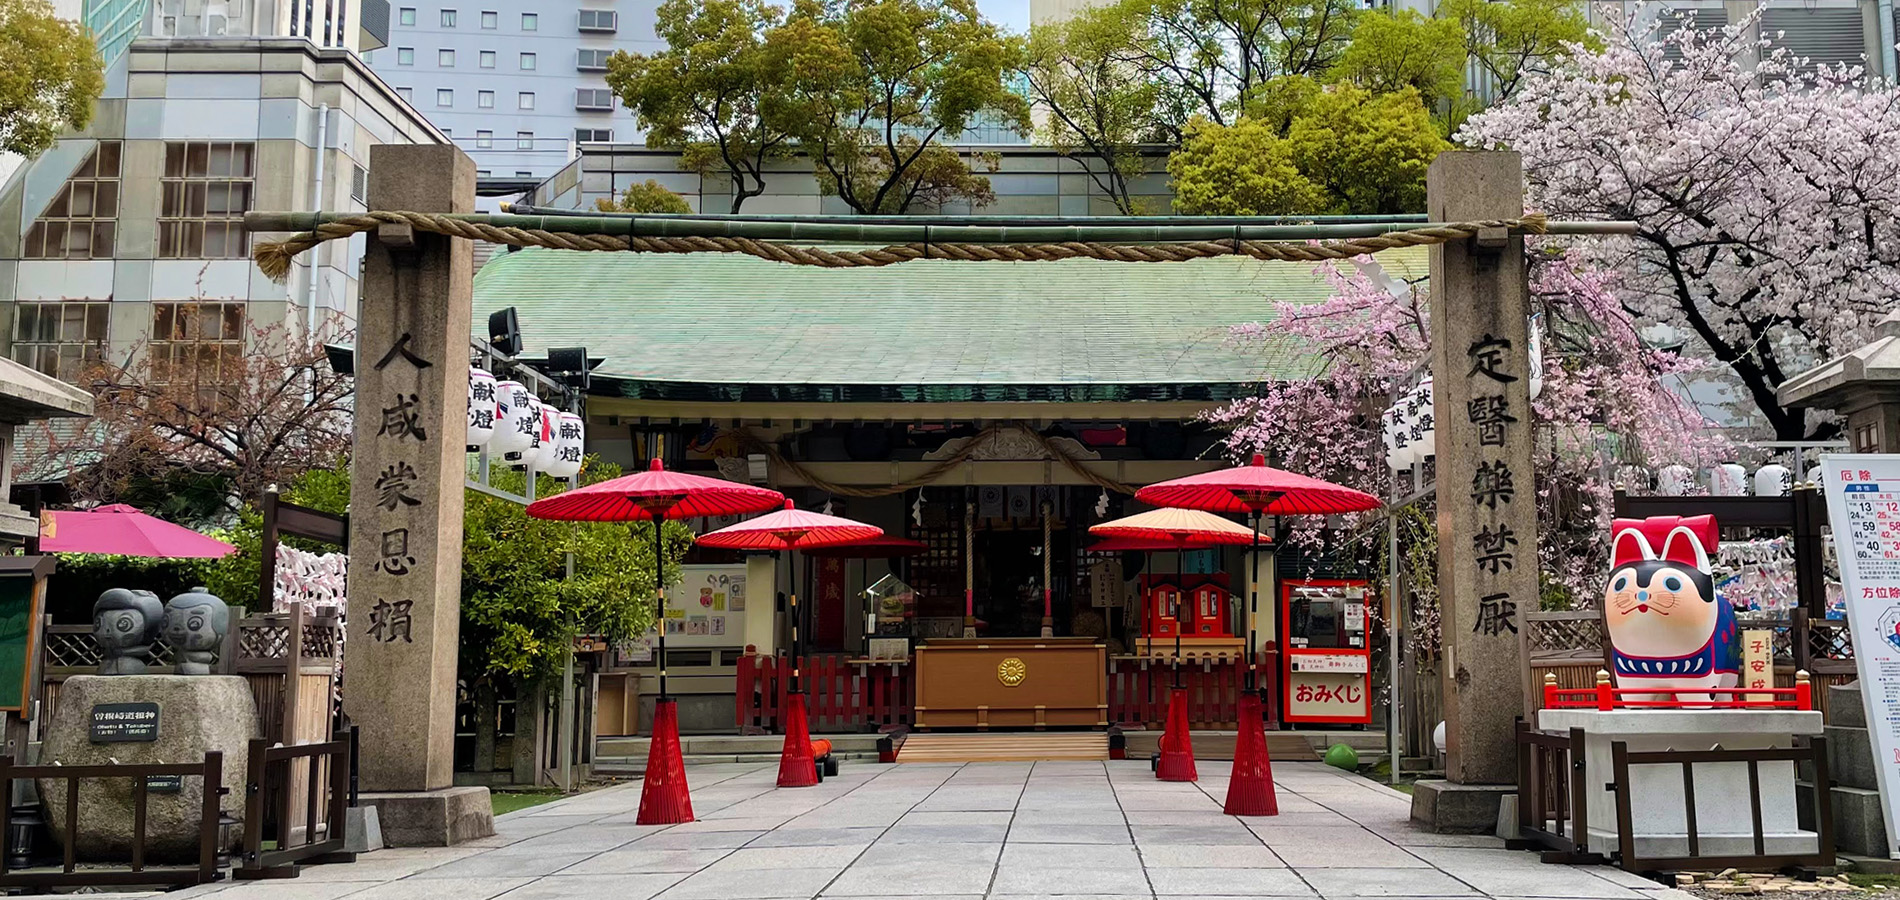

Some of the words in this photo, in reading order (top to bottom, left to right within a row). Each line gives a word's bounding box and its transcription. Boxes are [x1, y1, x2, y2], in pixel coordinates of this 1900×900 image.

[470, 381, 496, 430] 献燈
[1859, 502, 1872, 512] 13
[1886, 502, 1898, 512] 12
[1850, 511, 1860, 519] 24
[1877, 511, 1887, 519] 25
[1862, 521, 1876, 532] 59
[1854, 531, 1863, 539] 41
[1880, 531, 1890, 539] 42
[1866, 541, 1880, 551] 40
[1857, 551, 1867, 559] 60
[1884, 551, 1893, 559] 61
[1296, 683, 1361, 703] おみくじ
